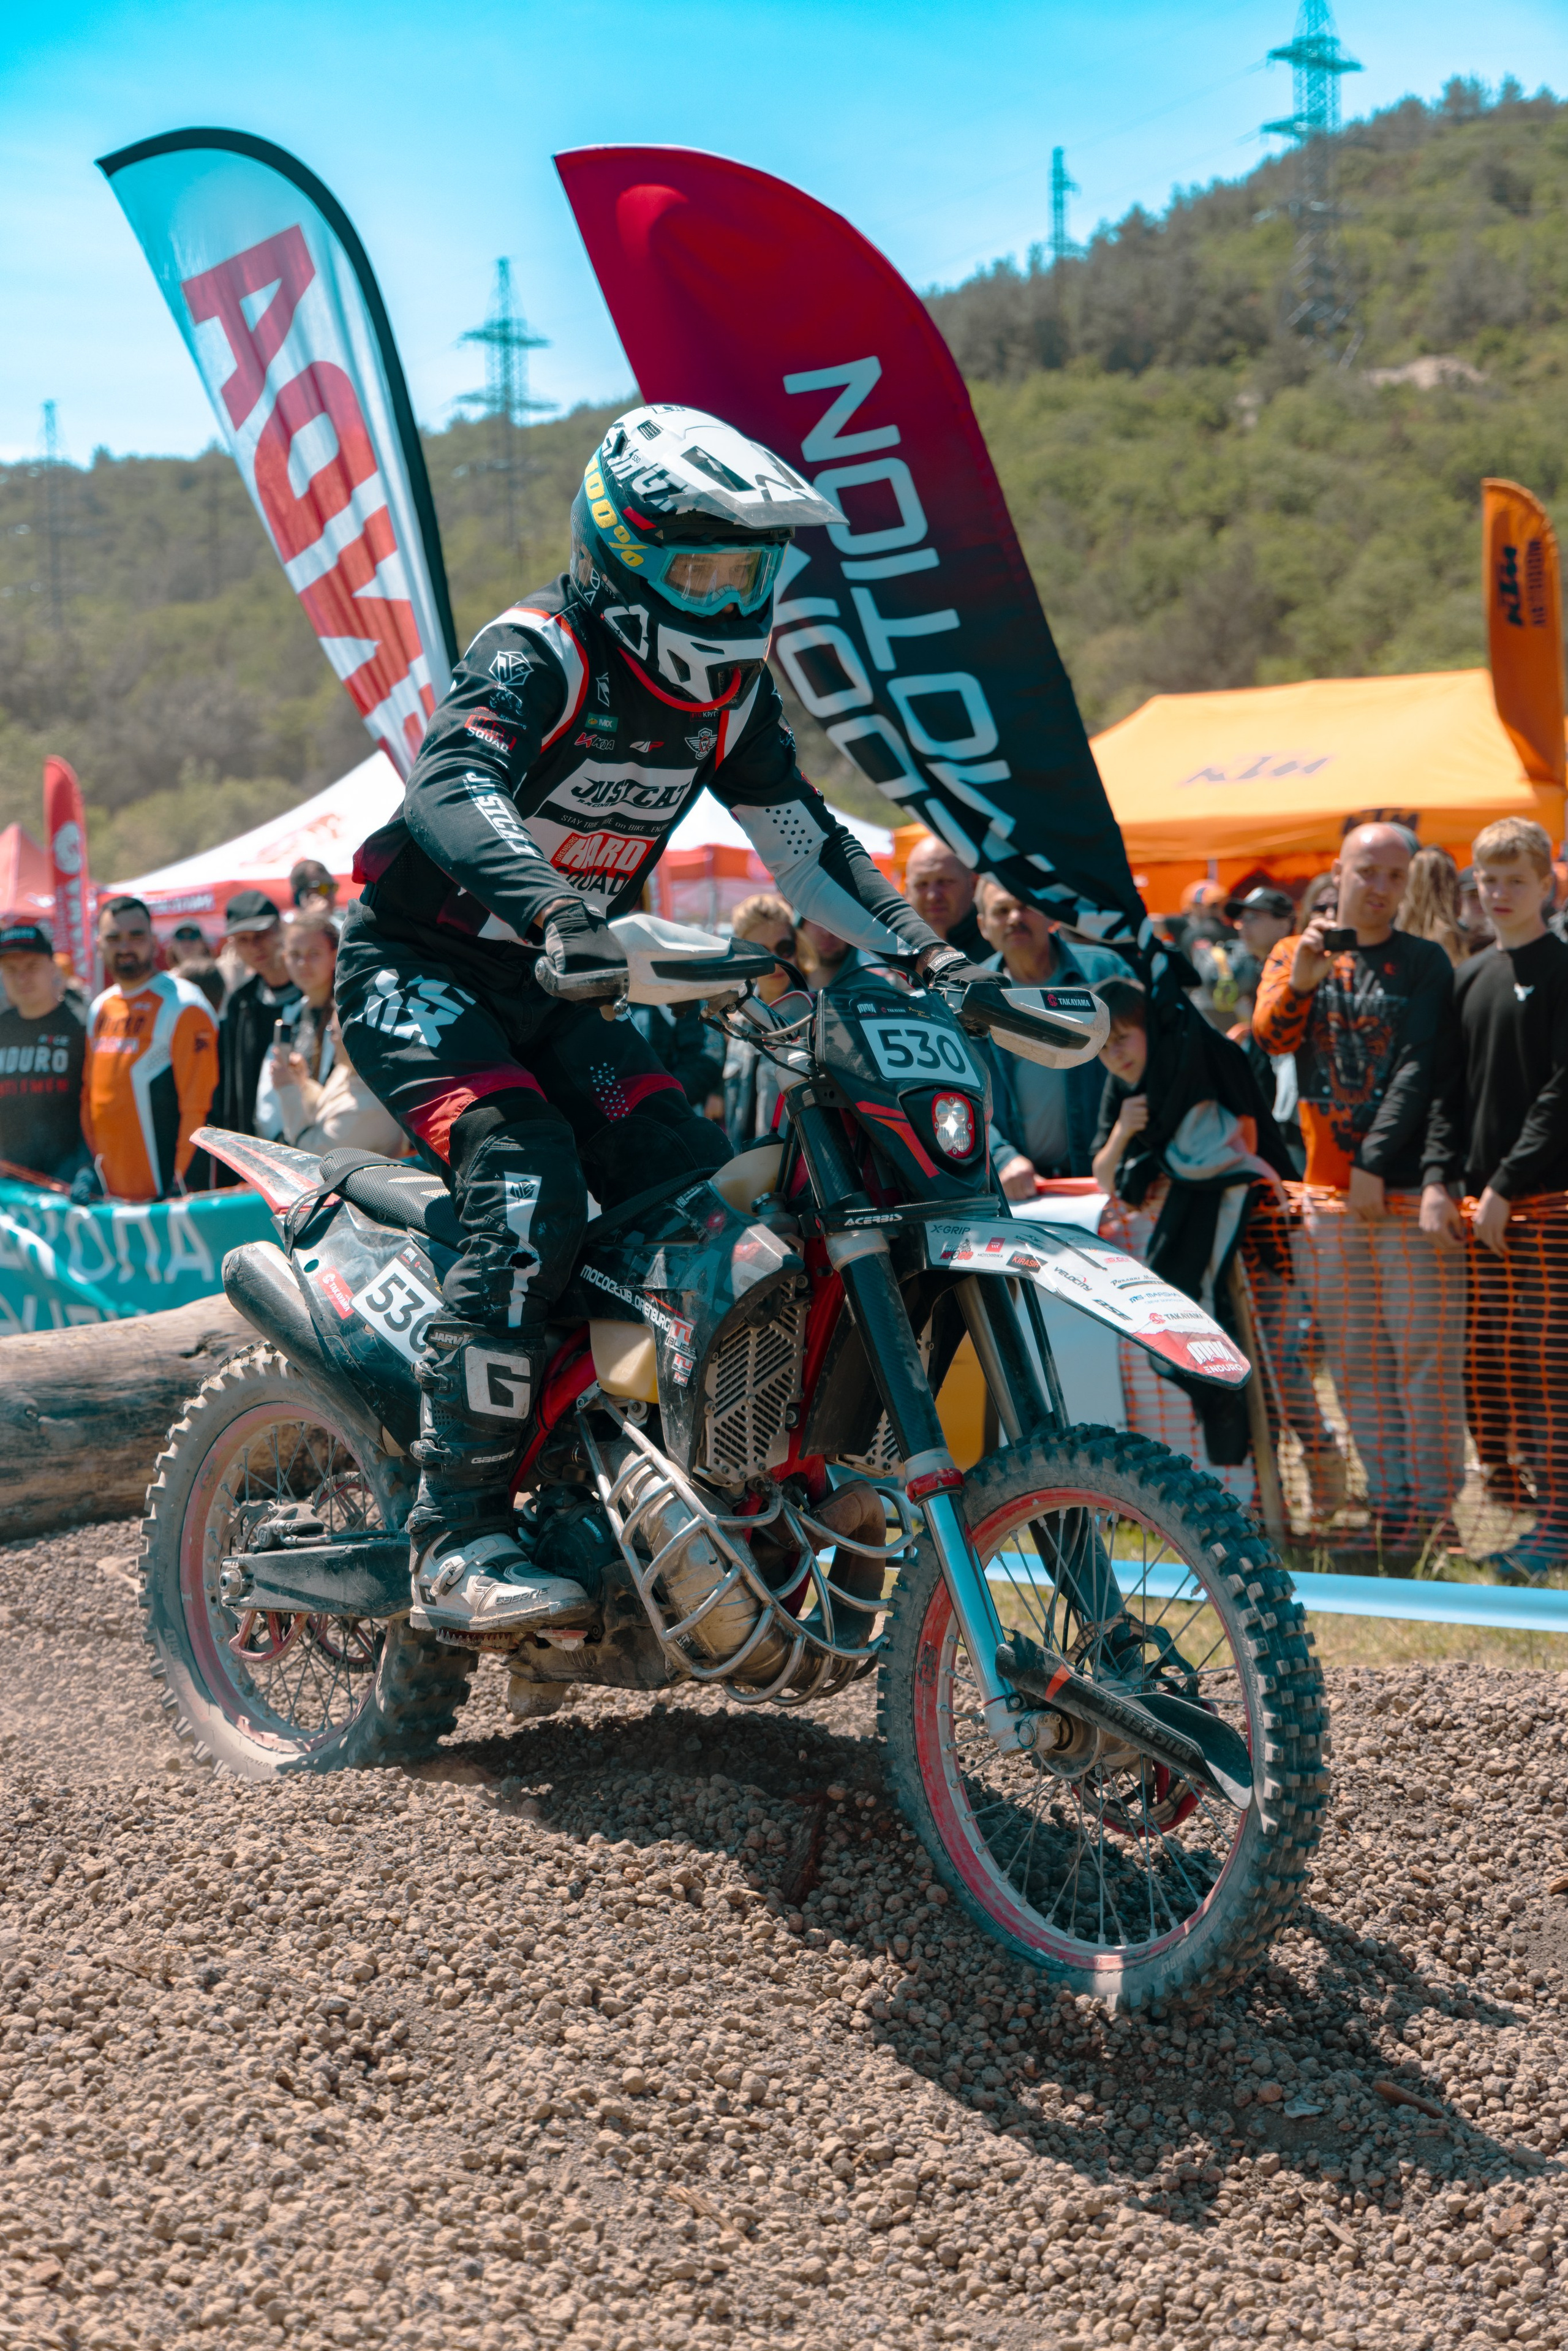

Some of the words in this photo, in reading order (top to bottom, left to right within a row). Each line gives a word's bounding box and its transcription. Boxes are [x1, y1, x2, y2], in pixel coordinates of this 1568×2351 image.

[631, 455, 641, 464] 530
[585, 455, 649, 567] 100%
[467, 726, 509, 752] SQUAD
[570, 776, 691, 809] JUSTCAT
[576, 798, 611, 808] RACING
[561, 815, 582, 826] STAY
[555, 836, 578, 861] ORENBURG
[560, 834, 647, 872] HARD
[1057, 998, 1091, 1007] TAKAYAMA
[876, 1029, 966, 1075] 530
[844, 1213, 903, 1226] ACERBIS
[930, 1225, 971, 1235] X-GRIP
[1054, 1266, 1093, 1292] VELOCITY
[328, 1281, 351, 1313] TAKAYAMA
[673, 1364, 690, 1376] BLISS
[674, 1354, 693, 1370] TU
[1202, 1363, 1244, 1374] ENDURO
[1101, 1700, 1193, 1762] MICHELIN
